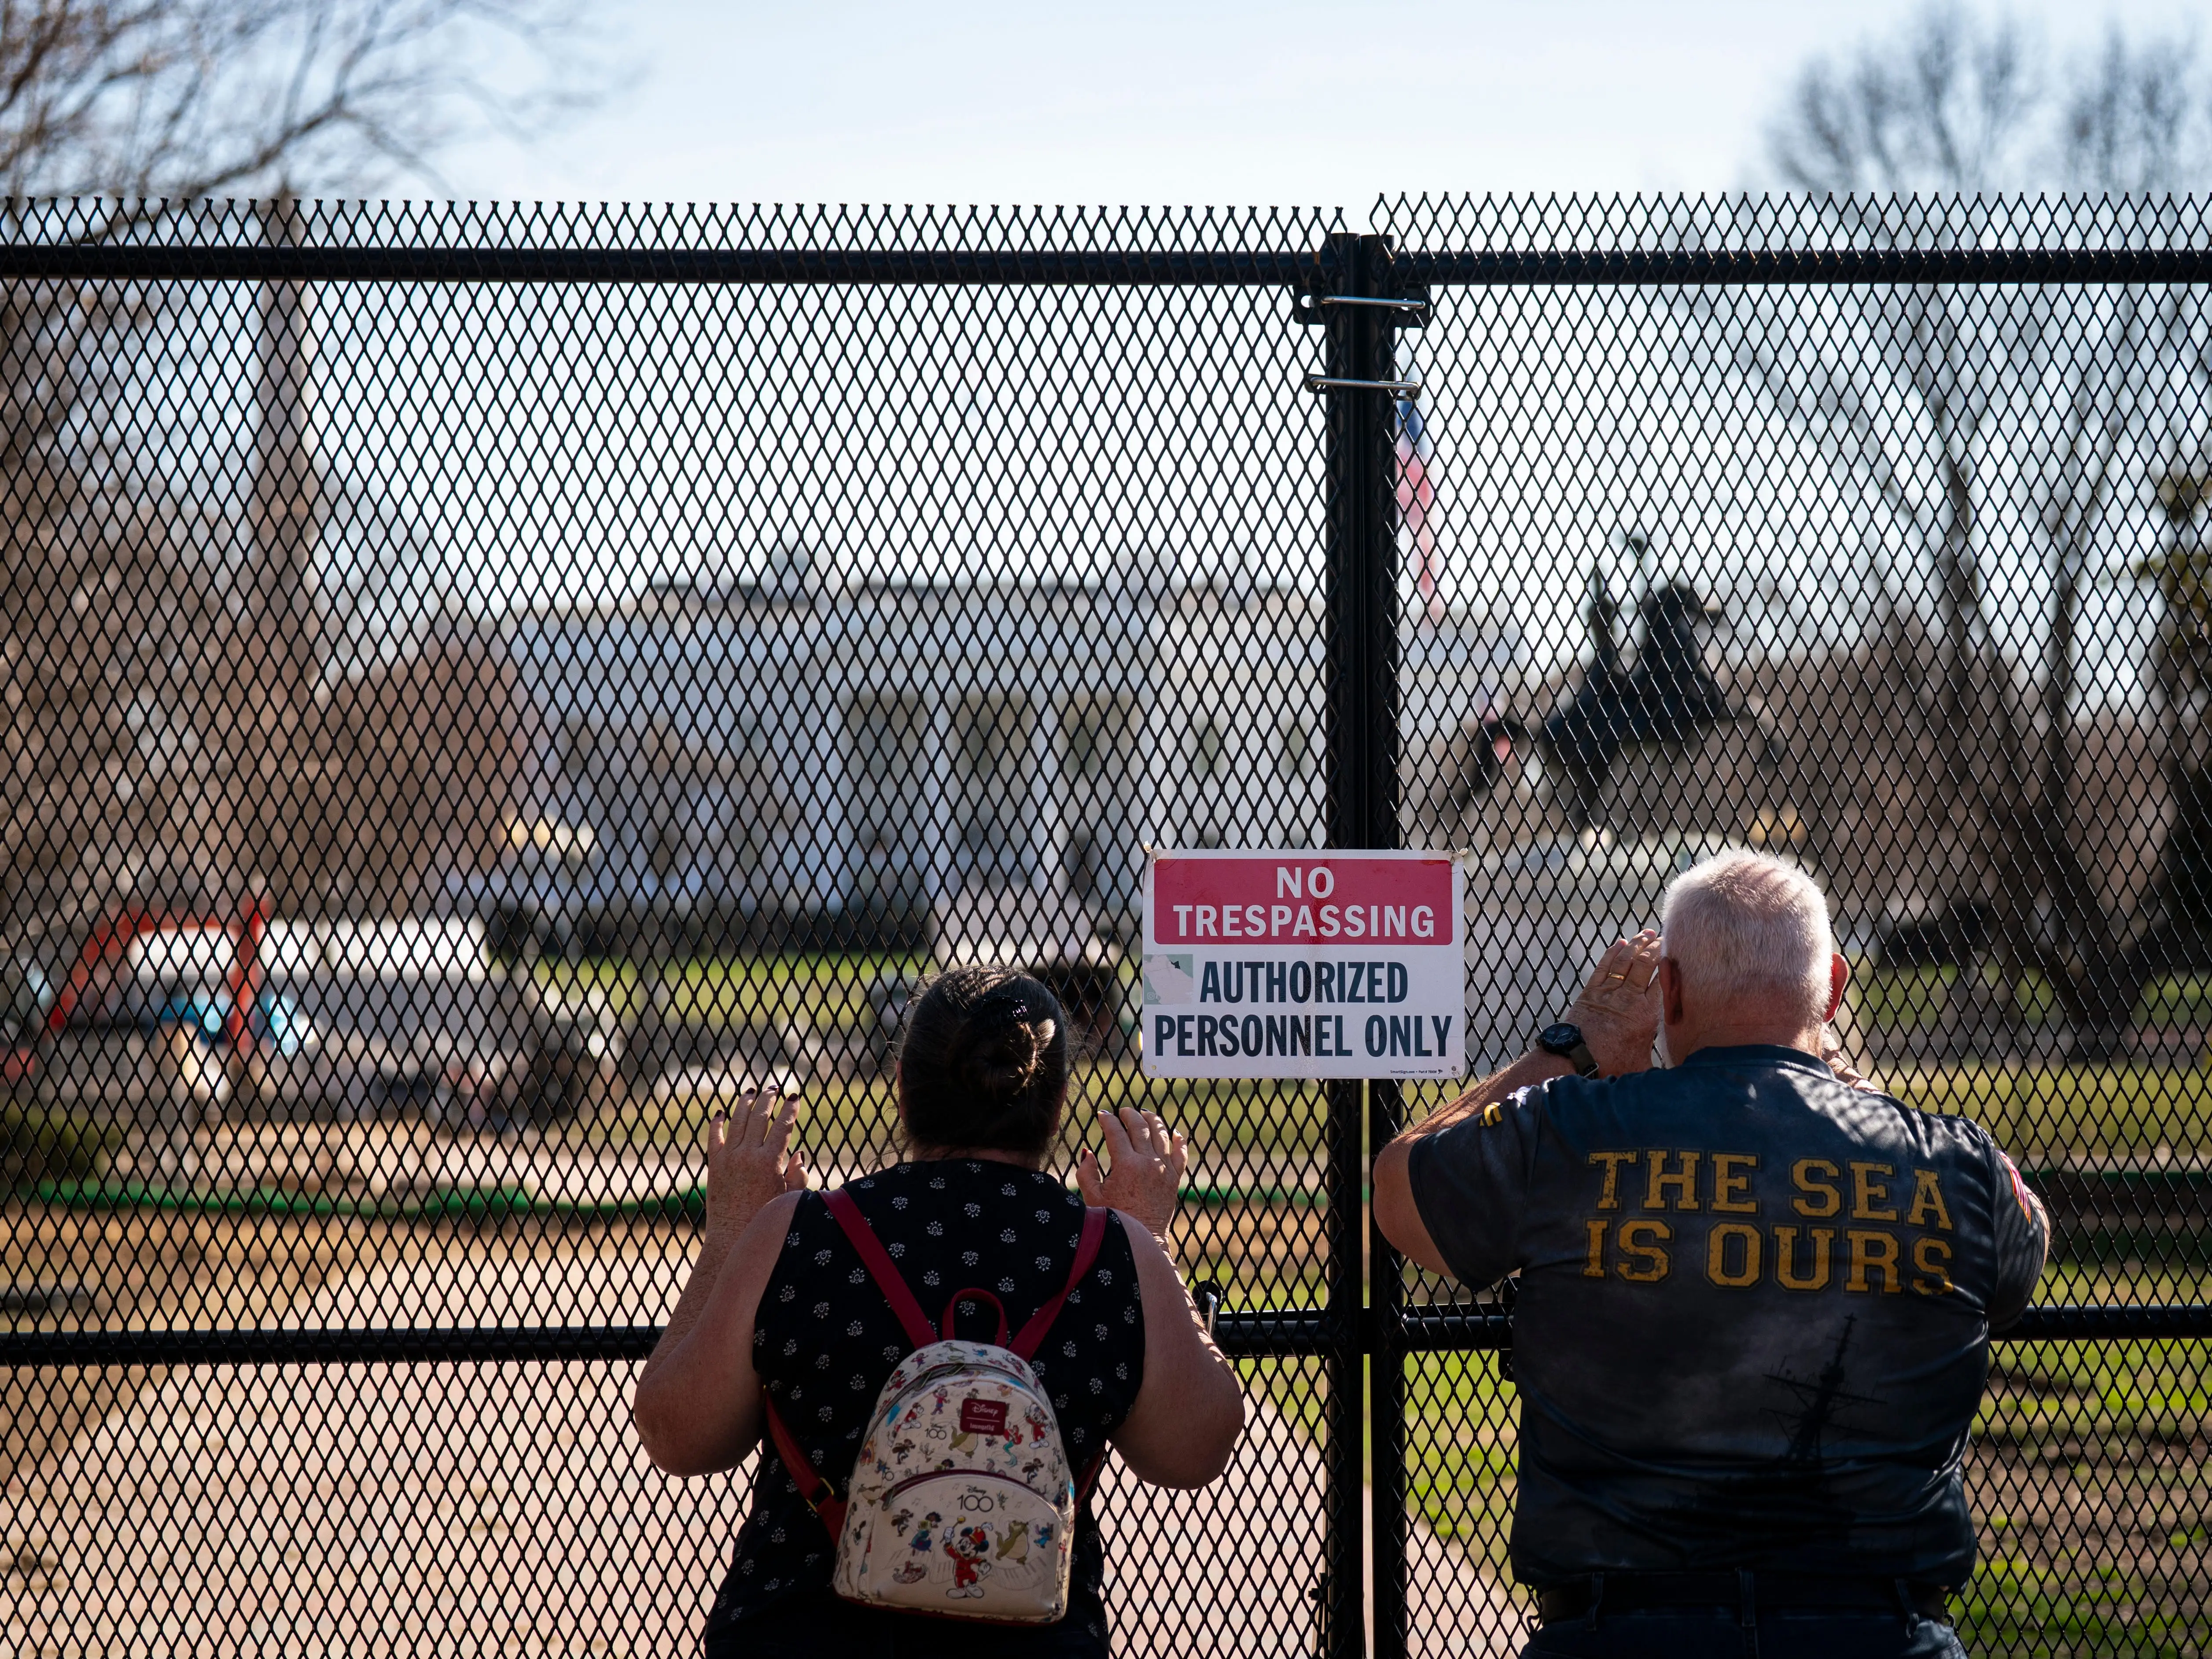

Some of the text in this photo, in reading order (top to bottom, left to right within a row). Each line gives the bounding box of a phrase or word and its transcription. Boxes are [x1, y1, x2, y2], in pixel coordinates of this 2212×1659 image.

[1276, 867, 1335, 898] NO
[1173, 905, 1435, 938] TRESPASSING
[1199, 961, 1408, 1004] AUTHORIZED
[1155, 1014, 1453, 1057] PERSONNEL ONLY
[1587, 1149, 1954, 1231] THE SEA
[1583, 1218, 1954, 1295] IS OURS
[971, 1402, 998, 1417] Disney
[924, 1428, 947, 1440] 100
[957, 1494, 994, 1512] 100
